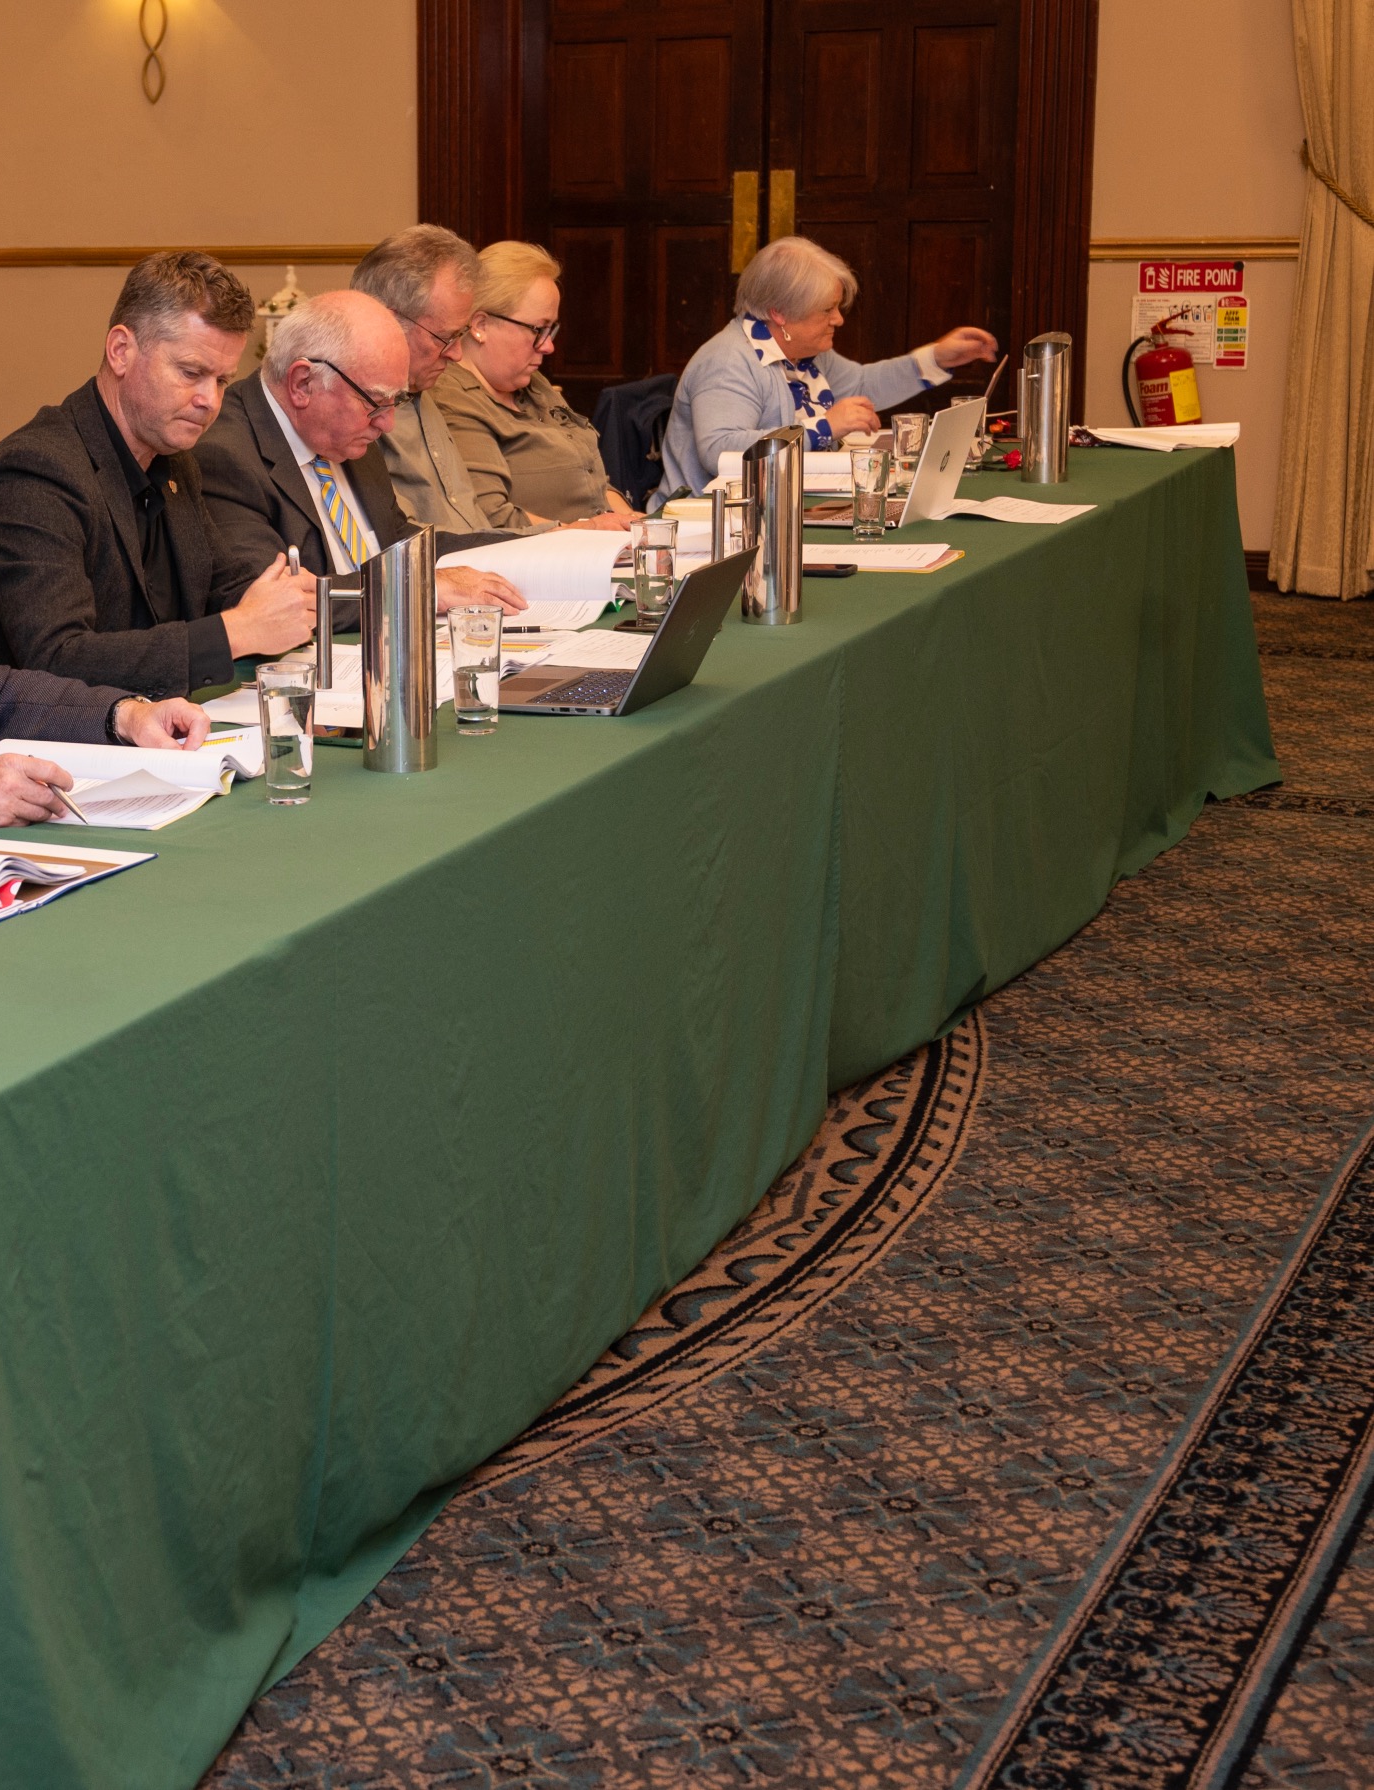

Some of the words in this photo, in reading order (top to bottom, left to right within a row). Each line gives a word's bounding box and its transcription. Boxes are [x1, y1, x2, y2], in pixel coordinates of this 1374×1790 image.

[1176, 269, 1201, 286] FIRE
[1204, 268, 1237, 287] POINT
[1139, 382, 1169, 395] Foam
